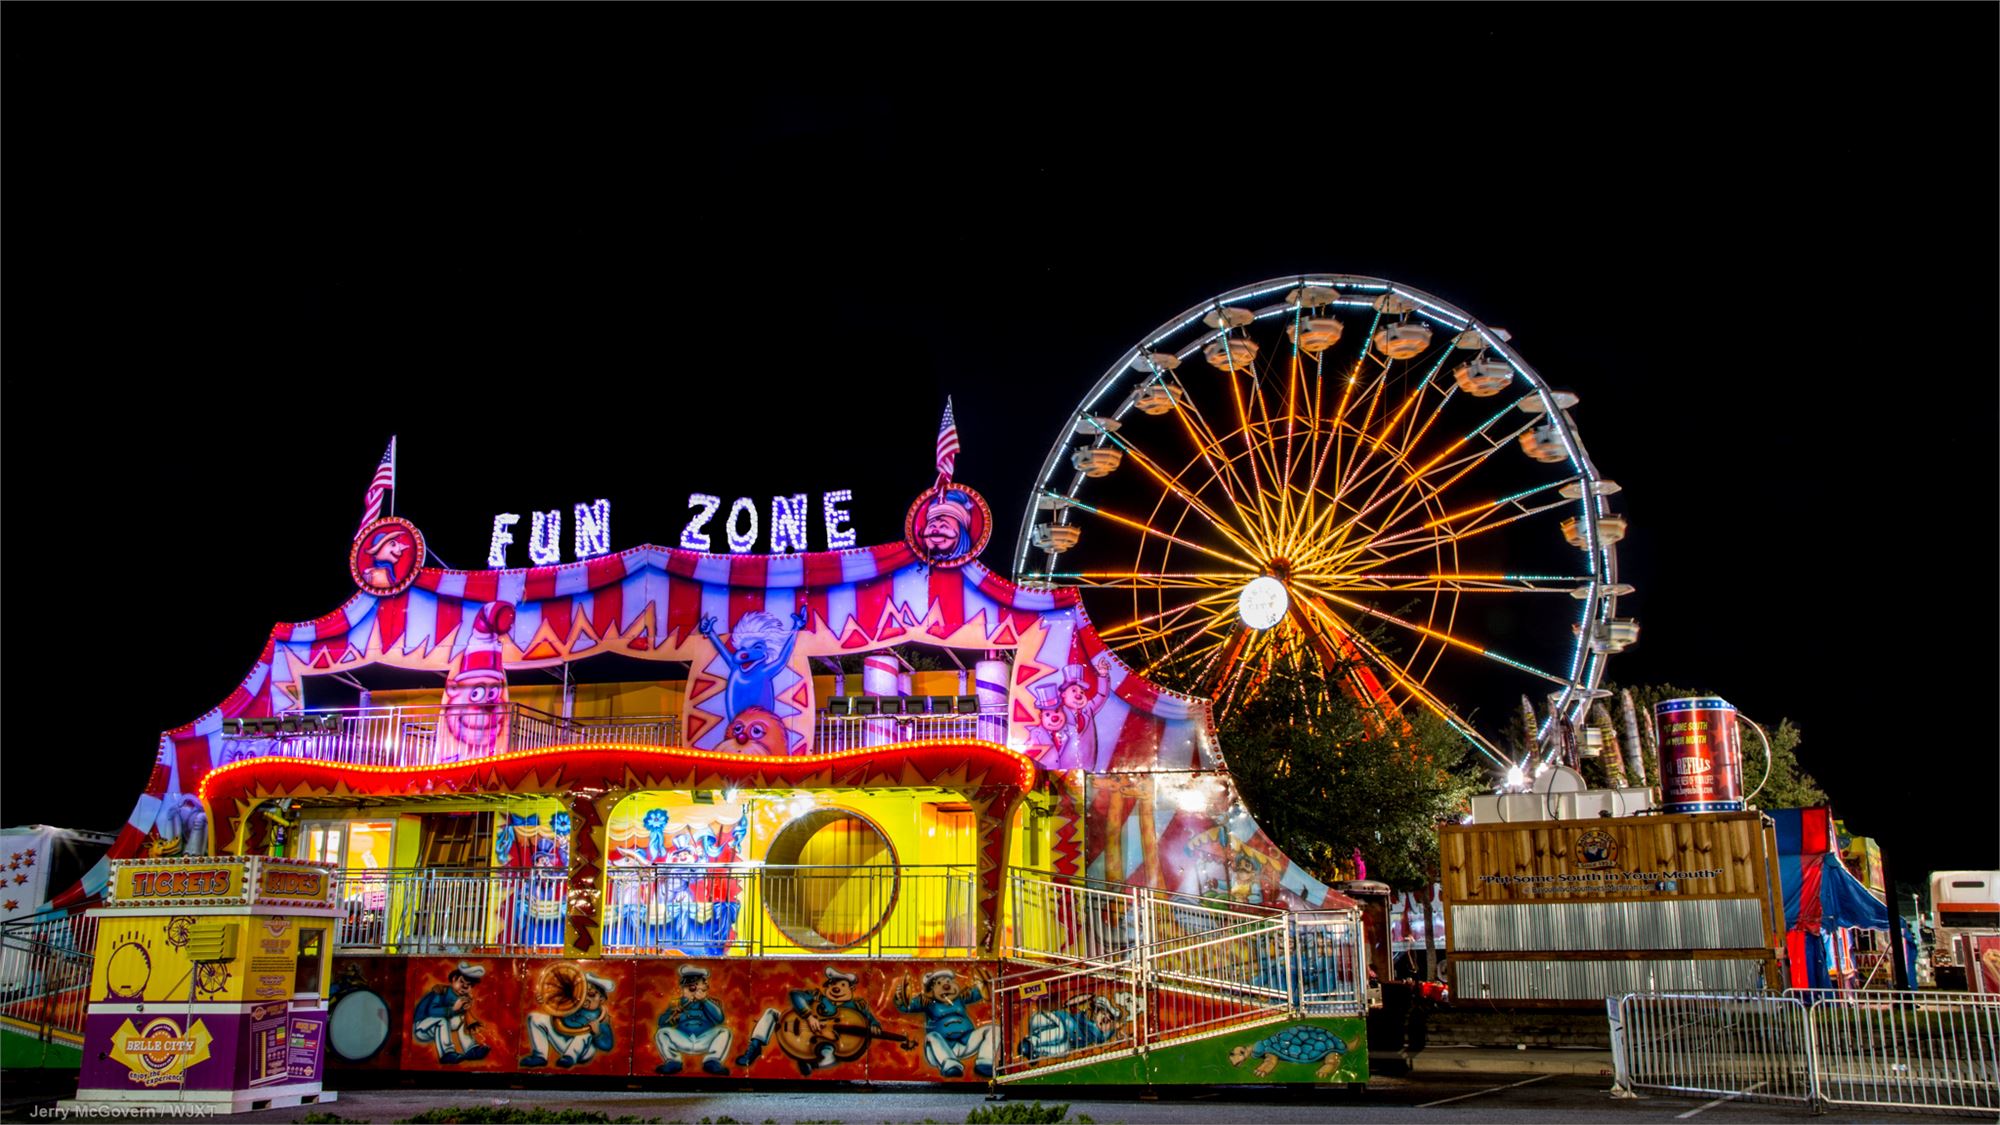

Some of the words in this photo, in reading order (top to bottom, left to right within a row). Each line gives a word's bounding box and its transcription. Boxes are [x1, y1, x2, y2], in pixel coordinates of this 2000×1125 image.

[488, 499, 610, 568] FUN
[680, 489, 856, 552] ZONE
[1676, 757, 1711, 775] REFILLS
[132, 870, 230, 897] TICKETS
[265, 870, 320, 896] RIDES
[1513, 874, 1554, 883] Some
[1558, 872, 1601, 882] South
[1605, 871, 1618, 880] in
[1623, 871, 1659, 881] Your
[1024, 984, 1041, 994] EXIT
[126, 1040, 161, 1051] BELLE
[164, 1040, 195, 1051] CITY
